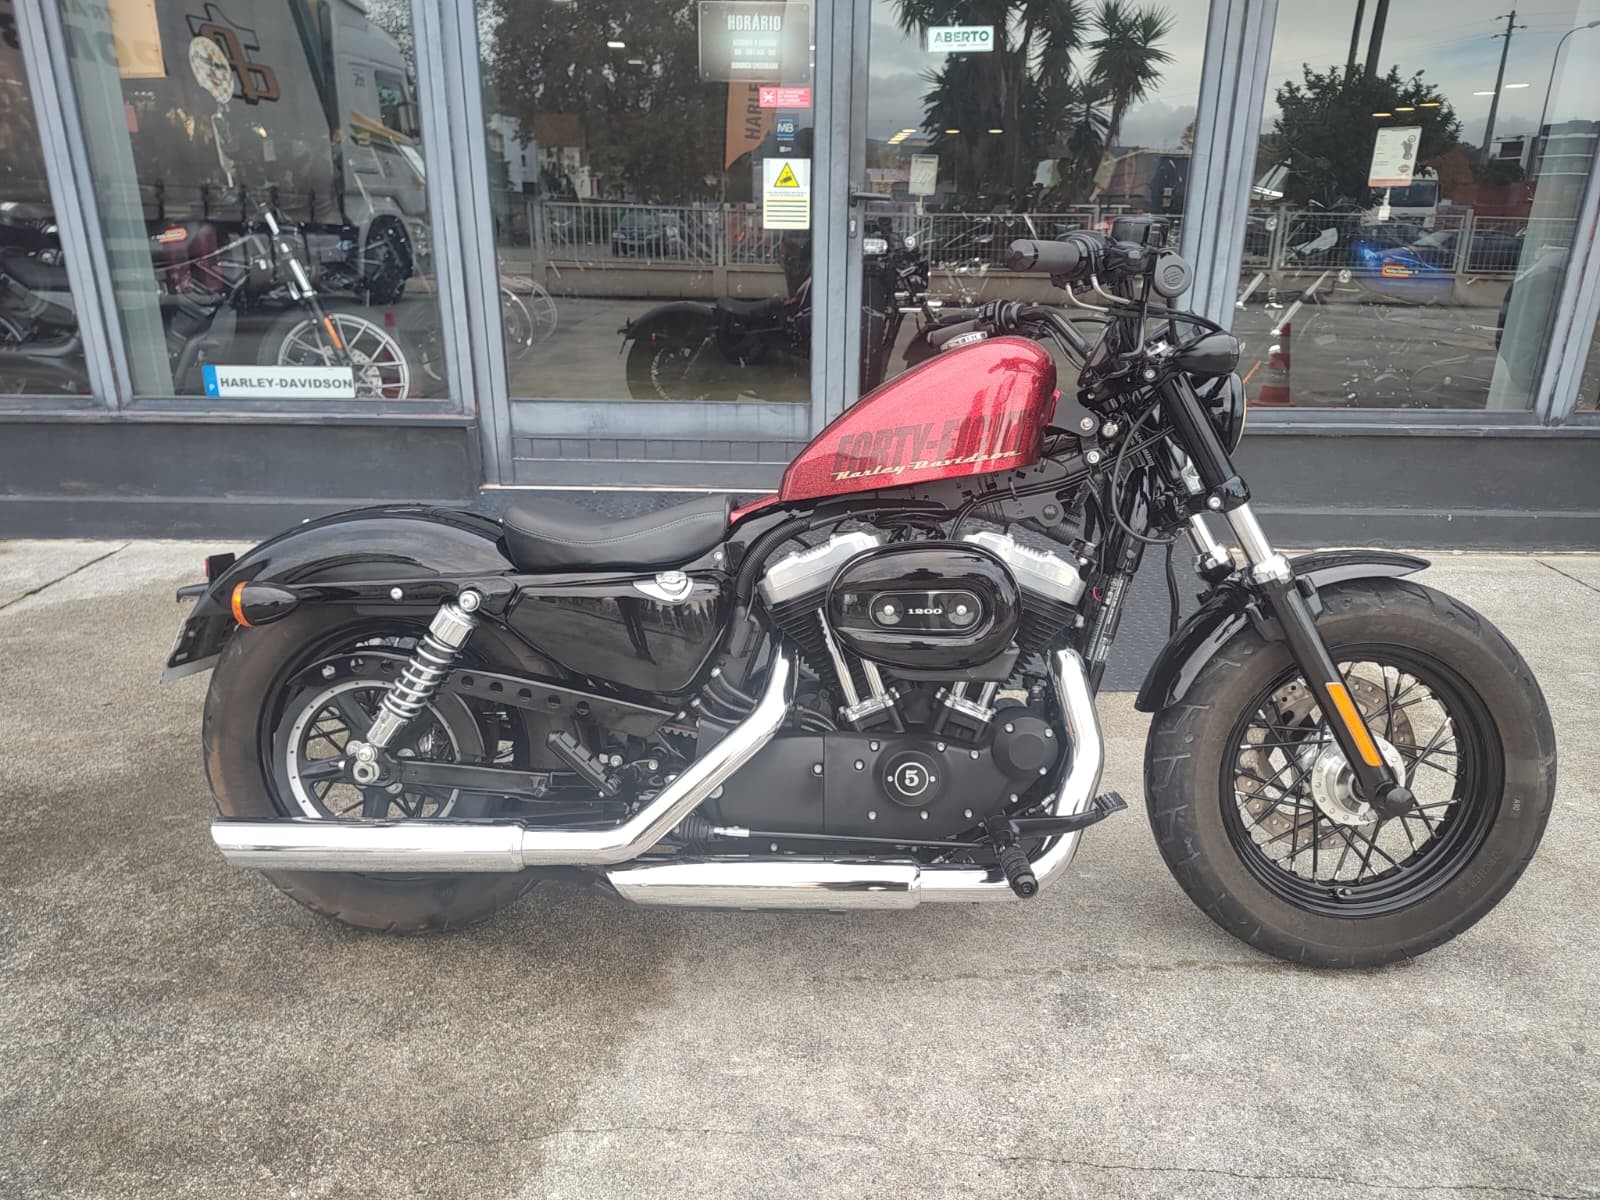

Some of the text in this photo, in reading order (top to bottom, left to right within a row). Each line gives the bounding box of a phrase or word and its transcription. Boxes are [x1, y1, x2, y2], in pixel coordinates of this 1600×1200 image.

[727, 12, 782, 31] HORÁRIO
[934, 30, 990, 43] ABERTO
[220, 377, 353, 389] HARLEY-DAVIDSON
[831, 450, 1023, 481] Harley-Davidson
[904, 769, 920, 787] 5
